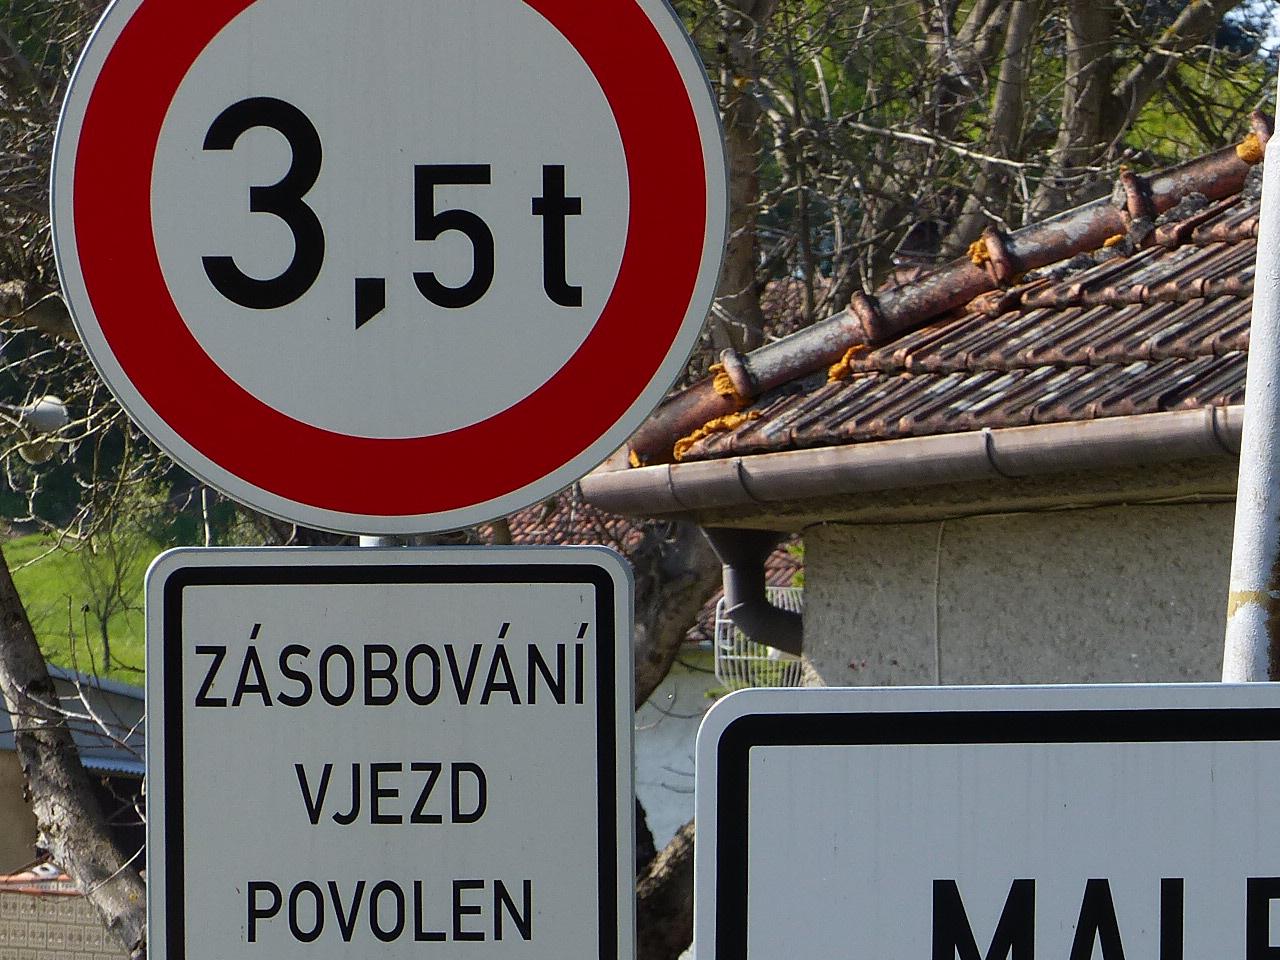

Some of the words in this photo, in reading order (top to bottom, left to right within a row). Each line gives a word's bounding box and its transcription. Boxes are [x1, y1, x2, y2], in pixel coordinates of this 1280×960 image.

[194, 623, 589, 708] ZÁSOBOVÁNÍ
[295, 762, 487, 826] VJEZD
[247, 880, 533, 943] POVOLEN
